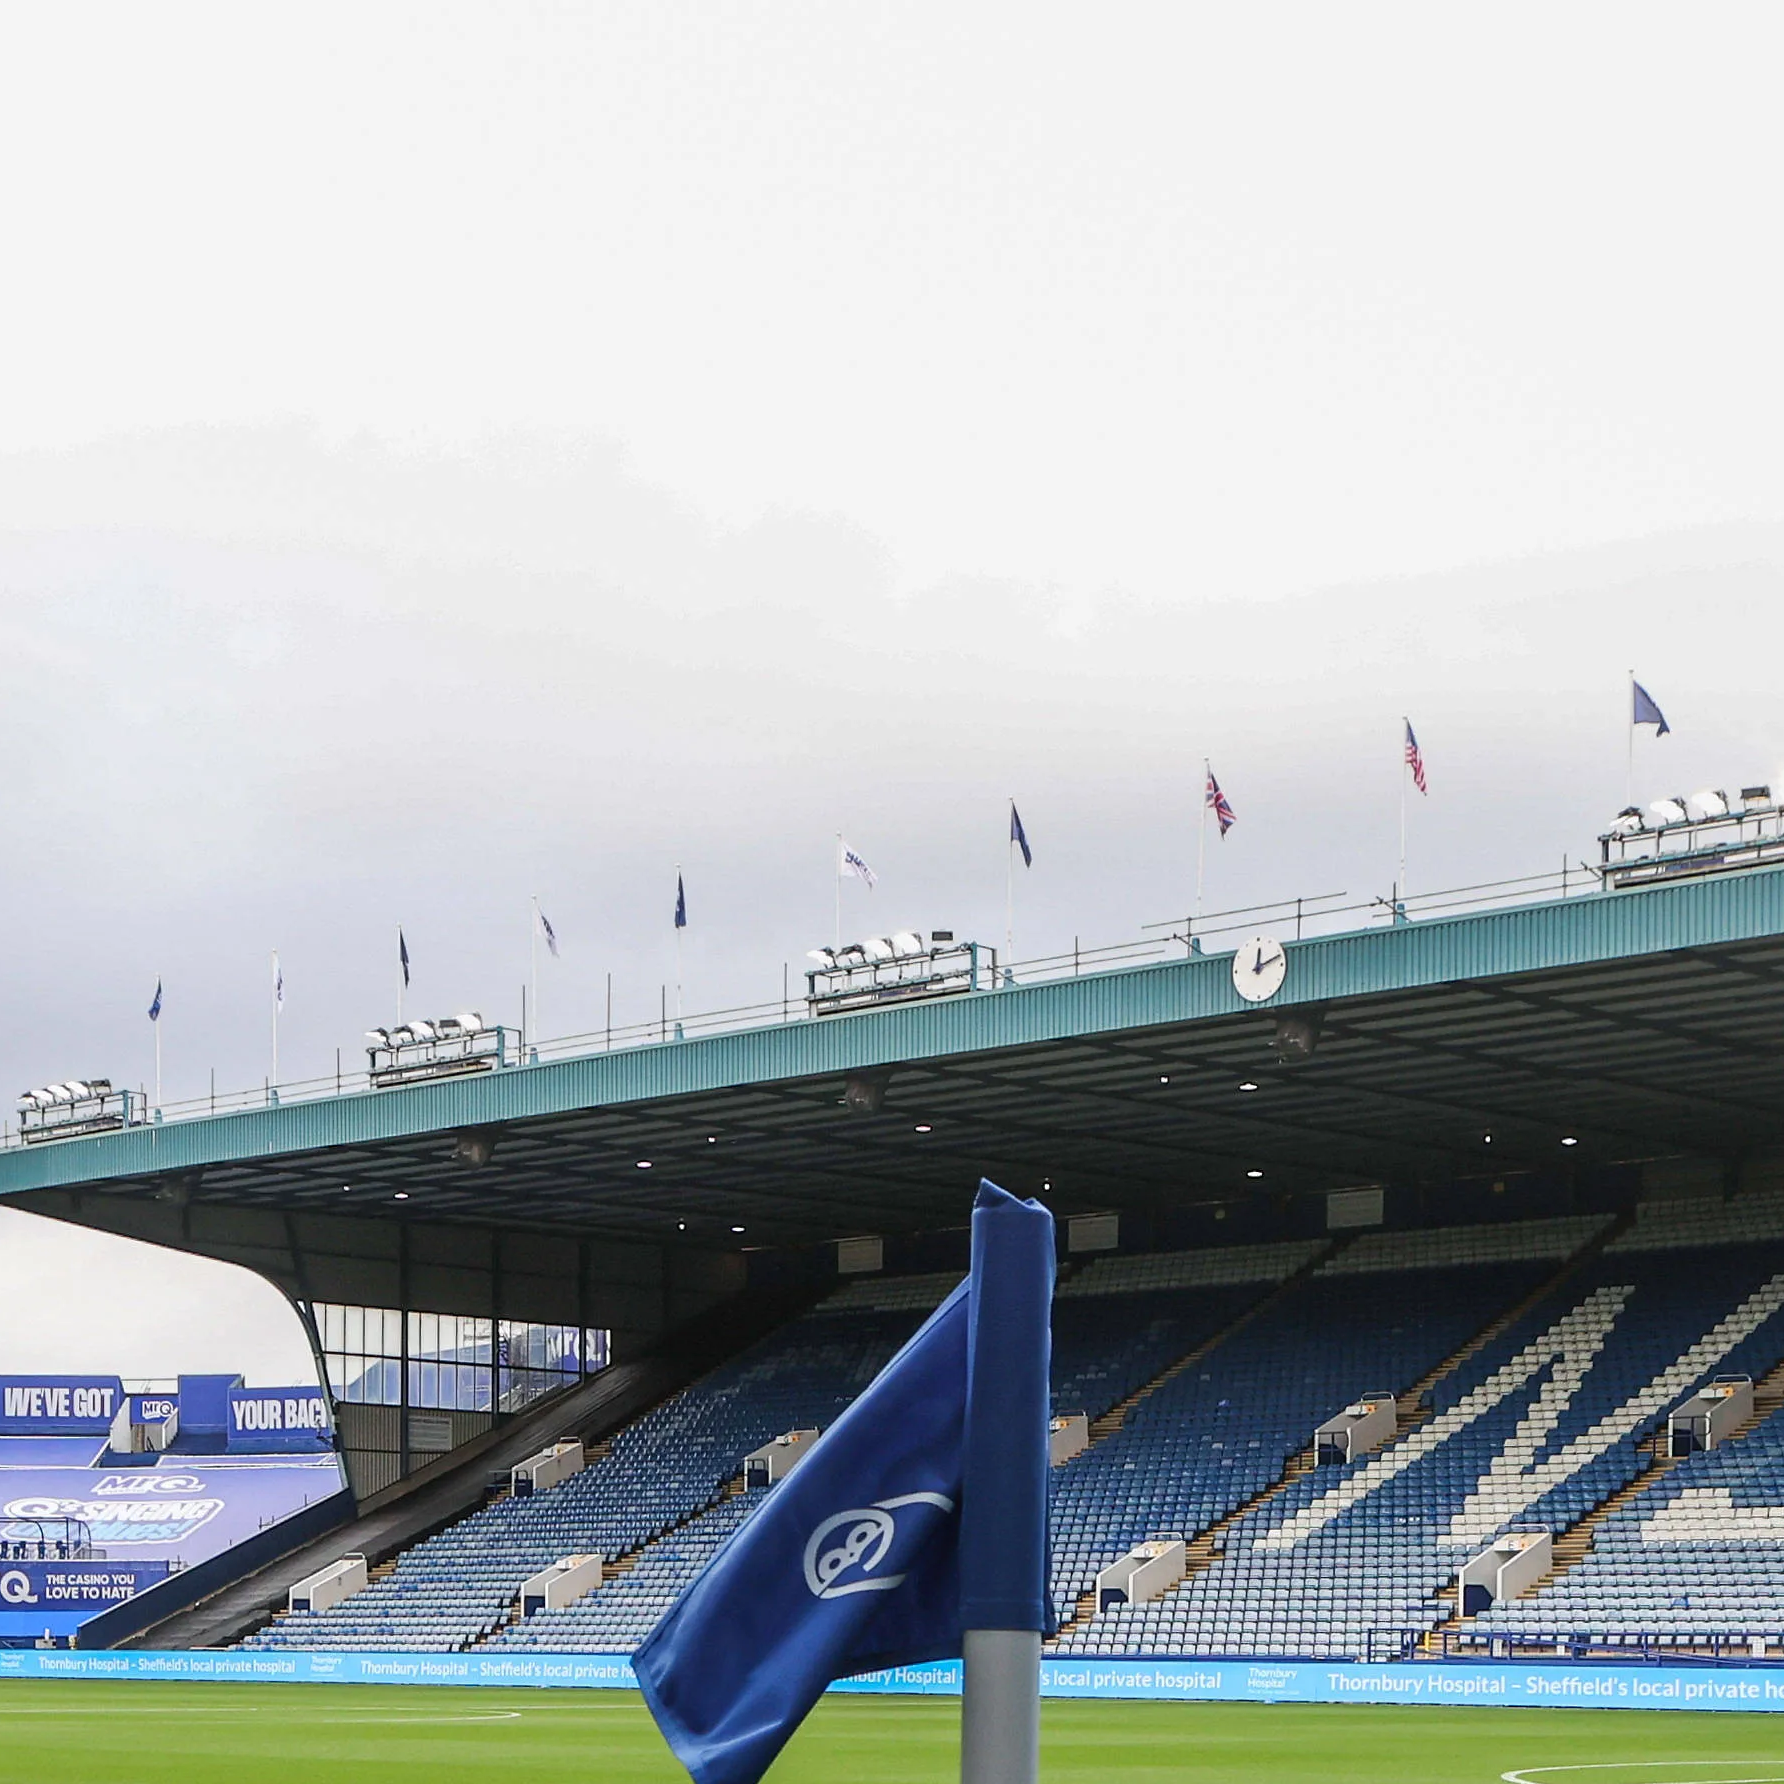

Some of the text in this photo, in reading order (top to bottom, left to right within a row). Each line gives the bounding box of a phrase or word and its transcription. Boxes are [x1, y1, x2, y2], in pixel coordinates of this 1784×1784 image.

[4, 1388, 114, 1417] WE'VE GOT
[232, 1399, 283, 1430] YOUR
[91, 1476, 207, 1494] MrQ
[76, 1501, 216, 1521] SINGING
[46, 1575, 135, 1584] THE CASINO YOU
[46, 1587, 135, 1599] LOVE TO HATE
[39, 1656, 87, 1671] Thornbury
[89, 1657, 129, 1673] Hospital
[138, 1658, 188, 1672] Sheffield's
[190, 1659, 214, 1672] local
[216, 1660, 252, 1674] private
[254, 1660, 295, 1674] hospital
[361, 1660, 419, 1675] Thornbury
[421, 1661, 468, 1676] Hospital
[480, 1662, 540, 1677] Sheffield's
[543, 1662, 573, 1677] local
[575, 1663, 618, 1679] private
[1248, 1668, 1298, 1680] Thornbury
[895, 1668, 956, 1685] Hospital
[1053, 1670, 1091, 1687] local
[1094, 1671, 1152, 1690] private
[1155, 1672, 1221, 1691] hospital
[1247, 1677, 1286, 1690] Hospital
[1327, 1673, 1424, 1697] Thornbury
[1428, 1674, 1505, 1697] Hospital
[1526, 1675, 1628, 1698] Sheffield's
[1632, 1678, 1680, 1698] local
[1684, 1679, 1760, 1701] private
